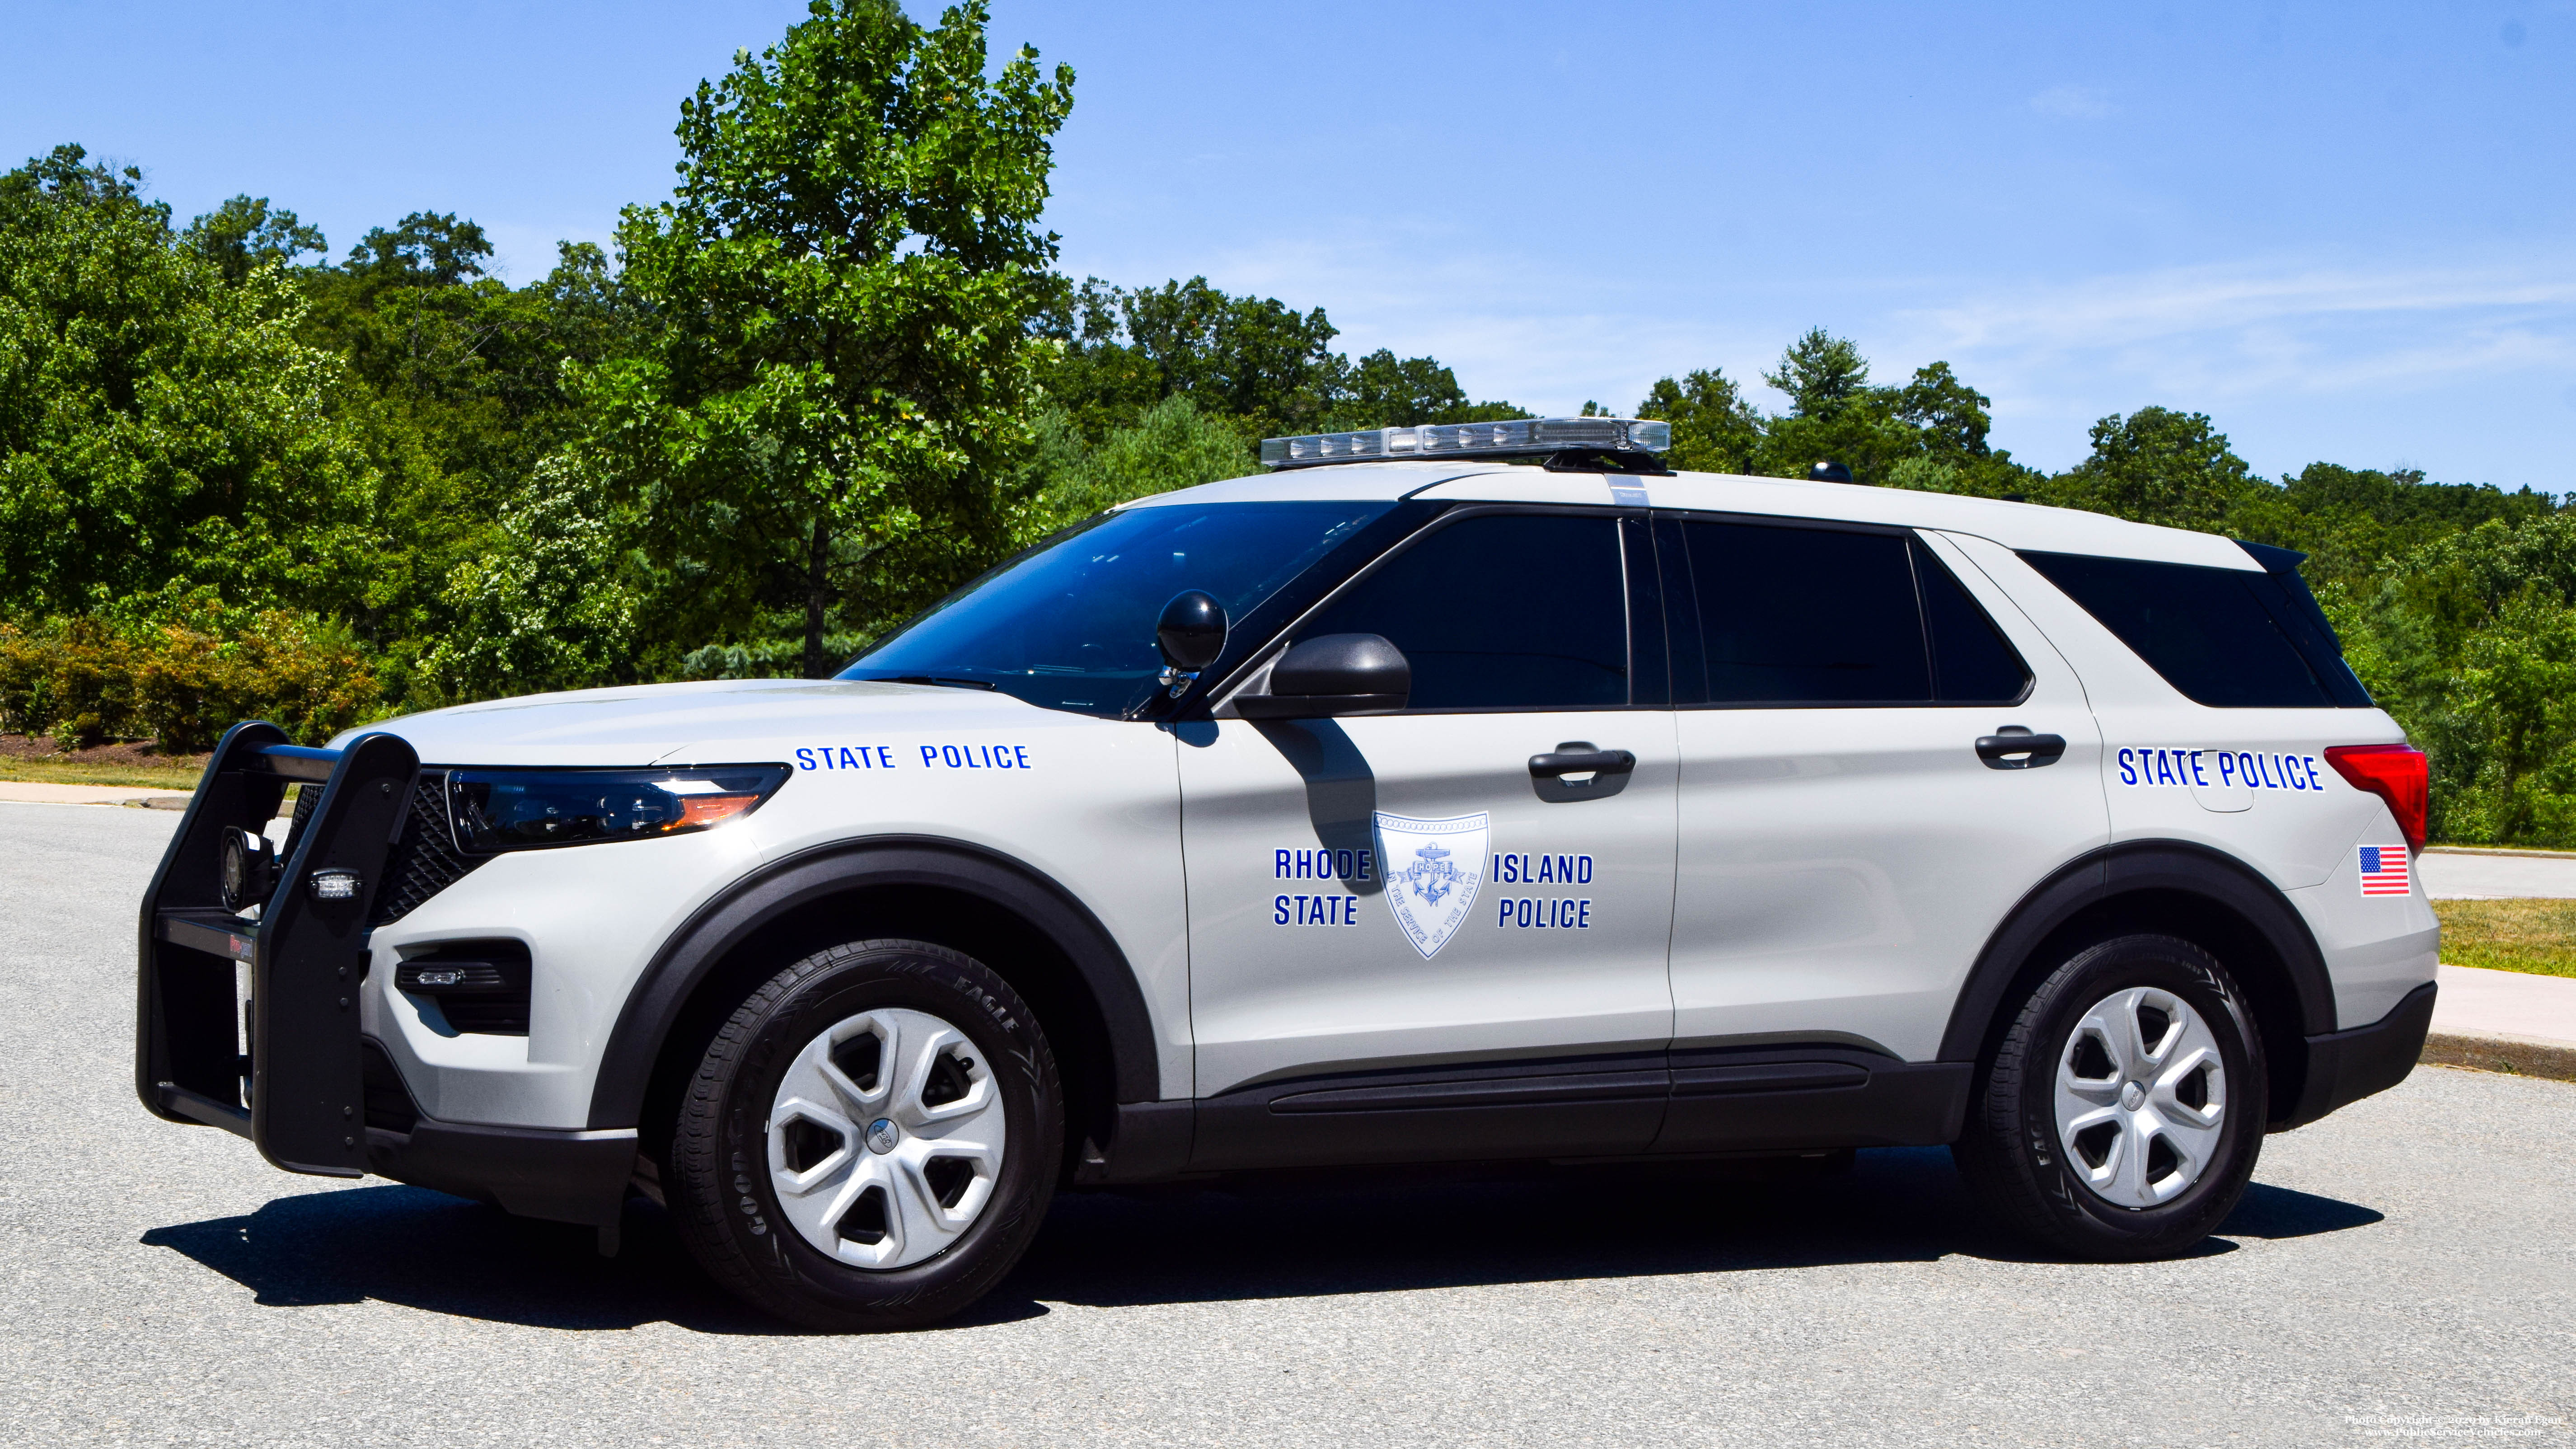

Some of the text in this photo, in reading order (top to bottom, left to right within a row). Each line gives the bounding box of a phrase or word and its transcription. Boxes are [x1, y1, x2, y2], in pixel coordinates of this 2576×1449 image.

[794, 744, 1033, 771] STATE POLICE
[2117, 747, 2326, 793] STATE POLICE
[1274, 848, 1593, 885] RHODE ISLAND
[1419, 863, 1445, 871] HOPE
[1273, 894, 1592, 929] STATE POLICE
[1387, 870, 1478, 944] IN THE SERVICE OF THE STATE
[953, 975, 1020, 1033] EAGLE
